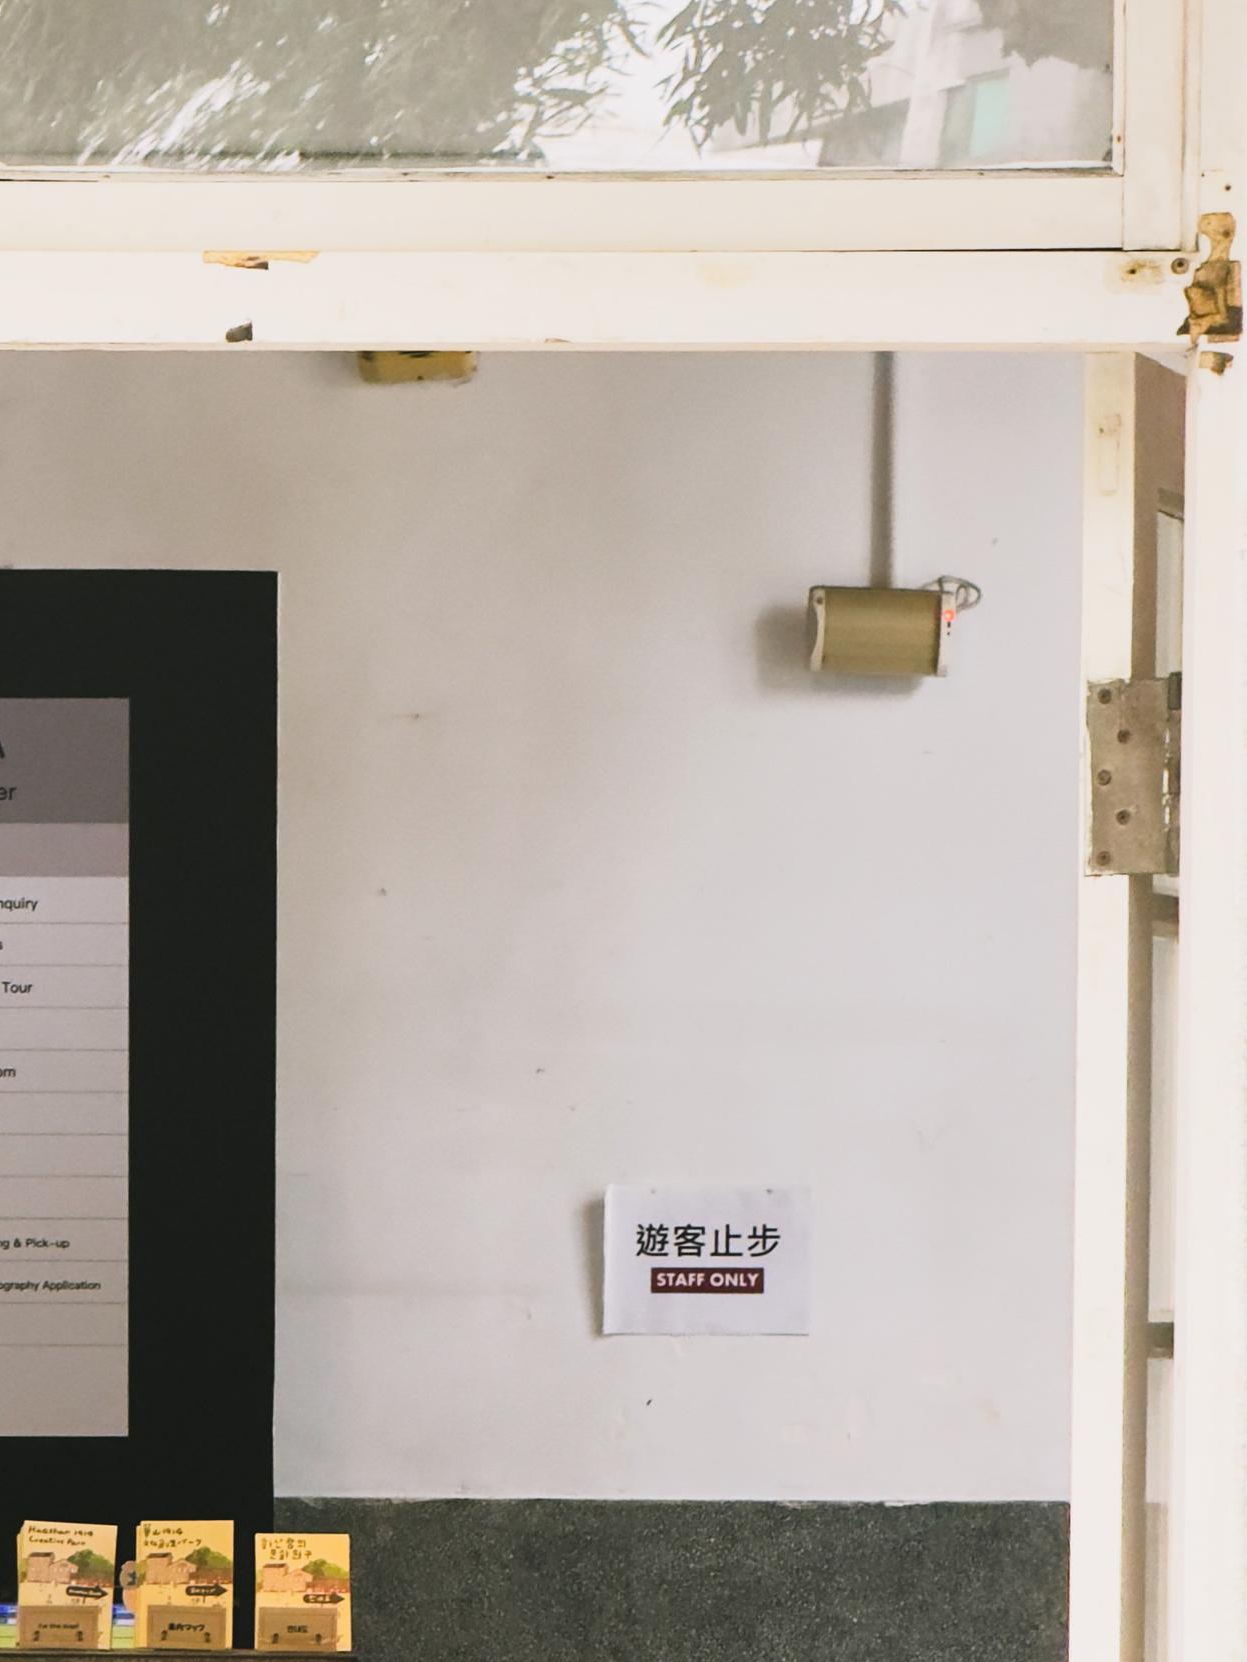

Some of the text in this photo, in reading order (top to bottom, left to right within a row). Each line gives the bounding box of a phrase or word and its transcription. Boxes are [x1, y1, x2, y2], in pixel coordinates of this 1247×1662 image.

[1, 981, 33, 995] Tour
[13, 1238, 22, 1248] &
[25, 1238, 70, 1250] Pick-up
[636, 1224, 781, 1257] 遊客止步
[42, 1280, 101, 1293] Application
[657, 1273, 759, 1287] STAFF ONLY
